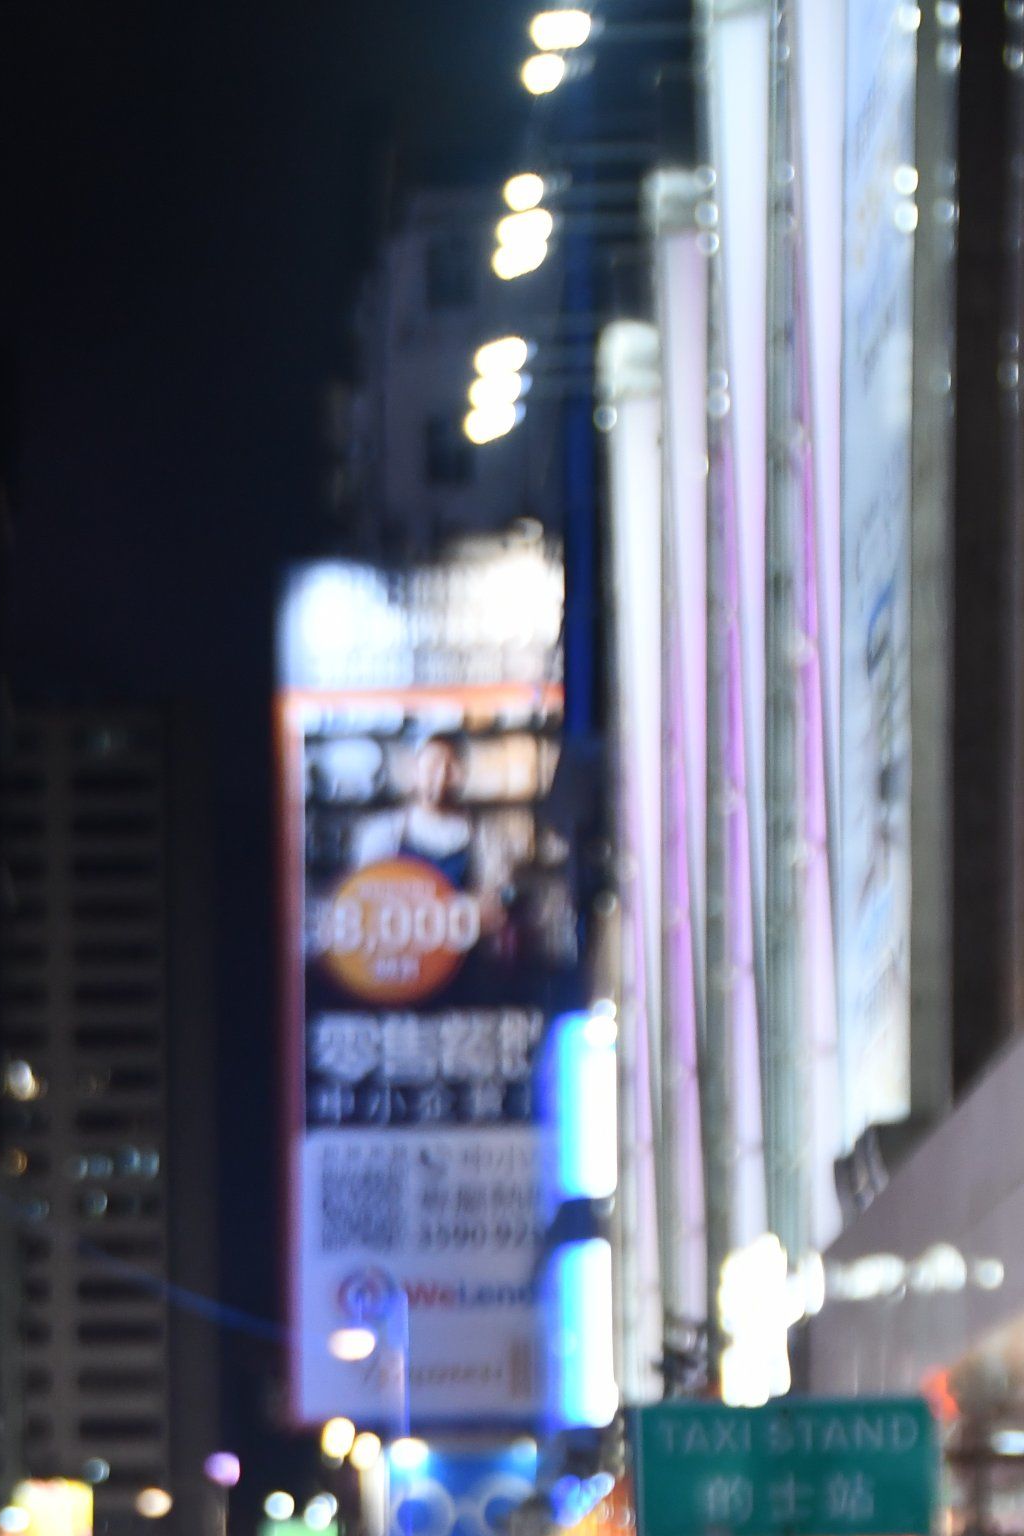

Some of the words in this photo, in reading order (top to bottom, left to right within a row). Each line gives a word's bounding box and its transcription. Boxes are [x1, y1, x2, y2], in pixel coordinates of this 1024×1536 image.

[658, 1418, 752, 1453] TAXI
[767, 1414, 920, 1453] STAND
[701, 1471, 876, 1525] 的士站
